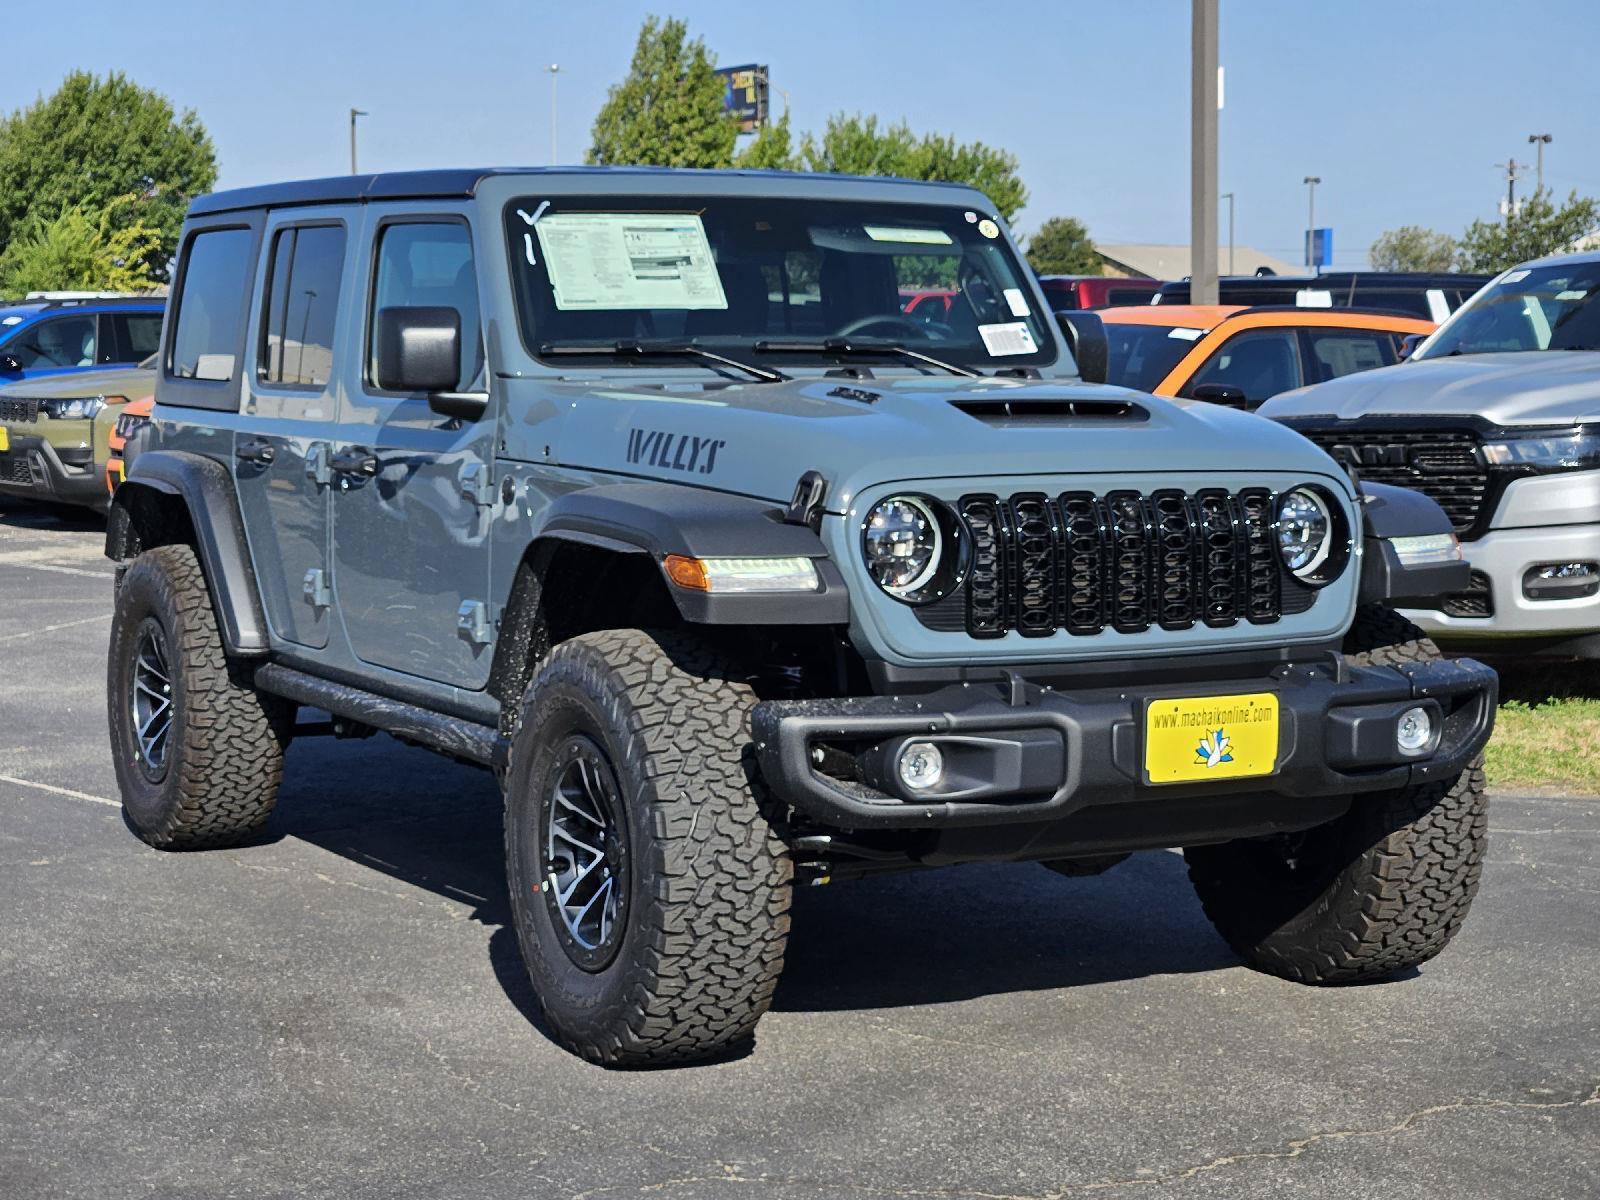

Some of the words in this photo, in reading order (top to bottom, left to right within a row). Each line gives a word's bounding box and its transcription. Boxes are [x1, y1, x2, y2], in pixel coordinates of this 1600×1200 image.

[626, 428, 726, 474] WILLYS
[1326, 443, 1406, 466] AM
[1153, 706, 1273, 729] www.machaikonline.com
